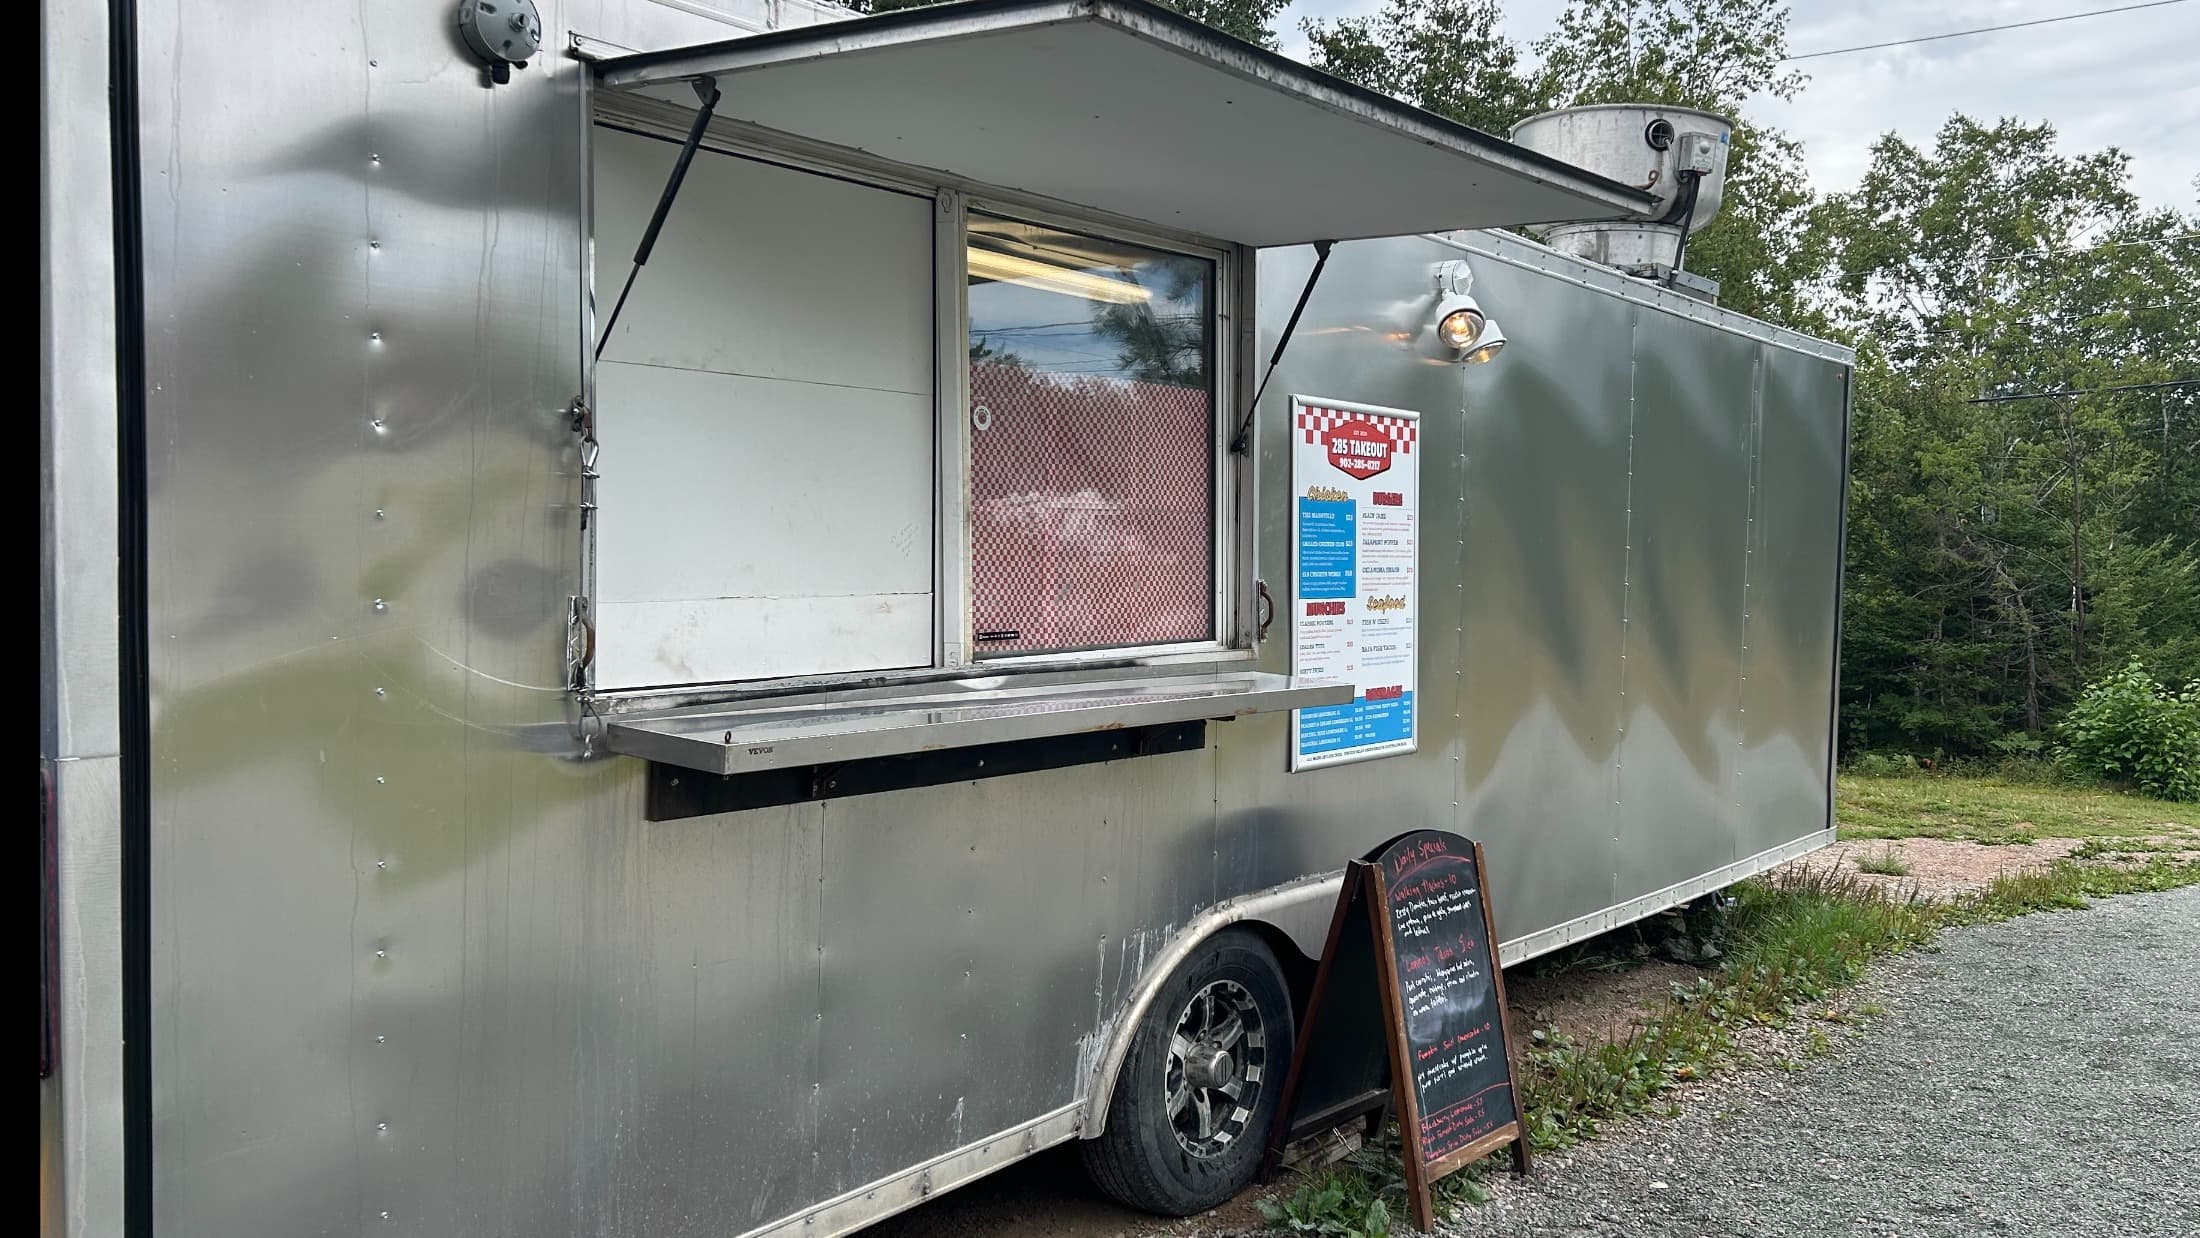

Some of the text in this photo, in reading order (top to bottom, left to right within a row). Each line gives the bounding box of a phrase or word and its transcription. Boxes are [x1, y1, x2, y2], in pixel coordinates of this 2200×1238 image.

[1332, 438, 1388, 458] 285 TAKEOUT
[1306, 601, 1346, 616] MUNCHIES
[1366, 594, 1406, 614] Seafood
[748, 746, 774, 755] VEVOR
[1394, 837, 1448, 876] Daily Specials
[1395, 883, 1422, 902] Walking
